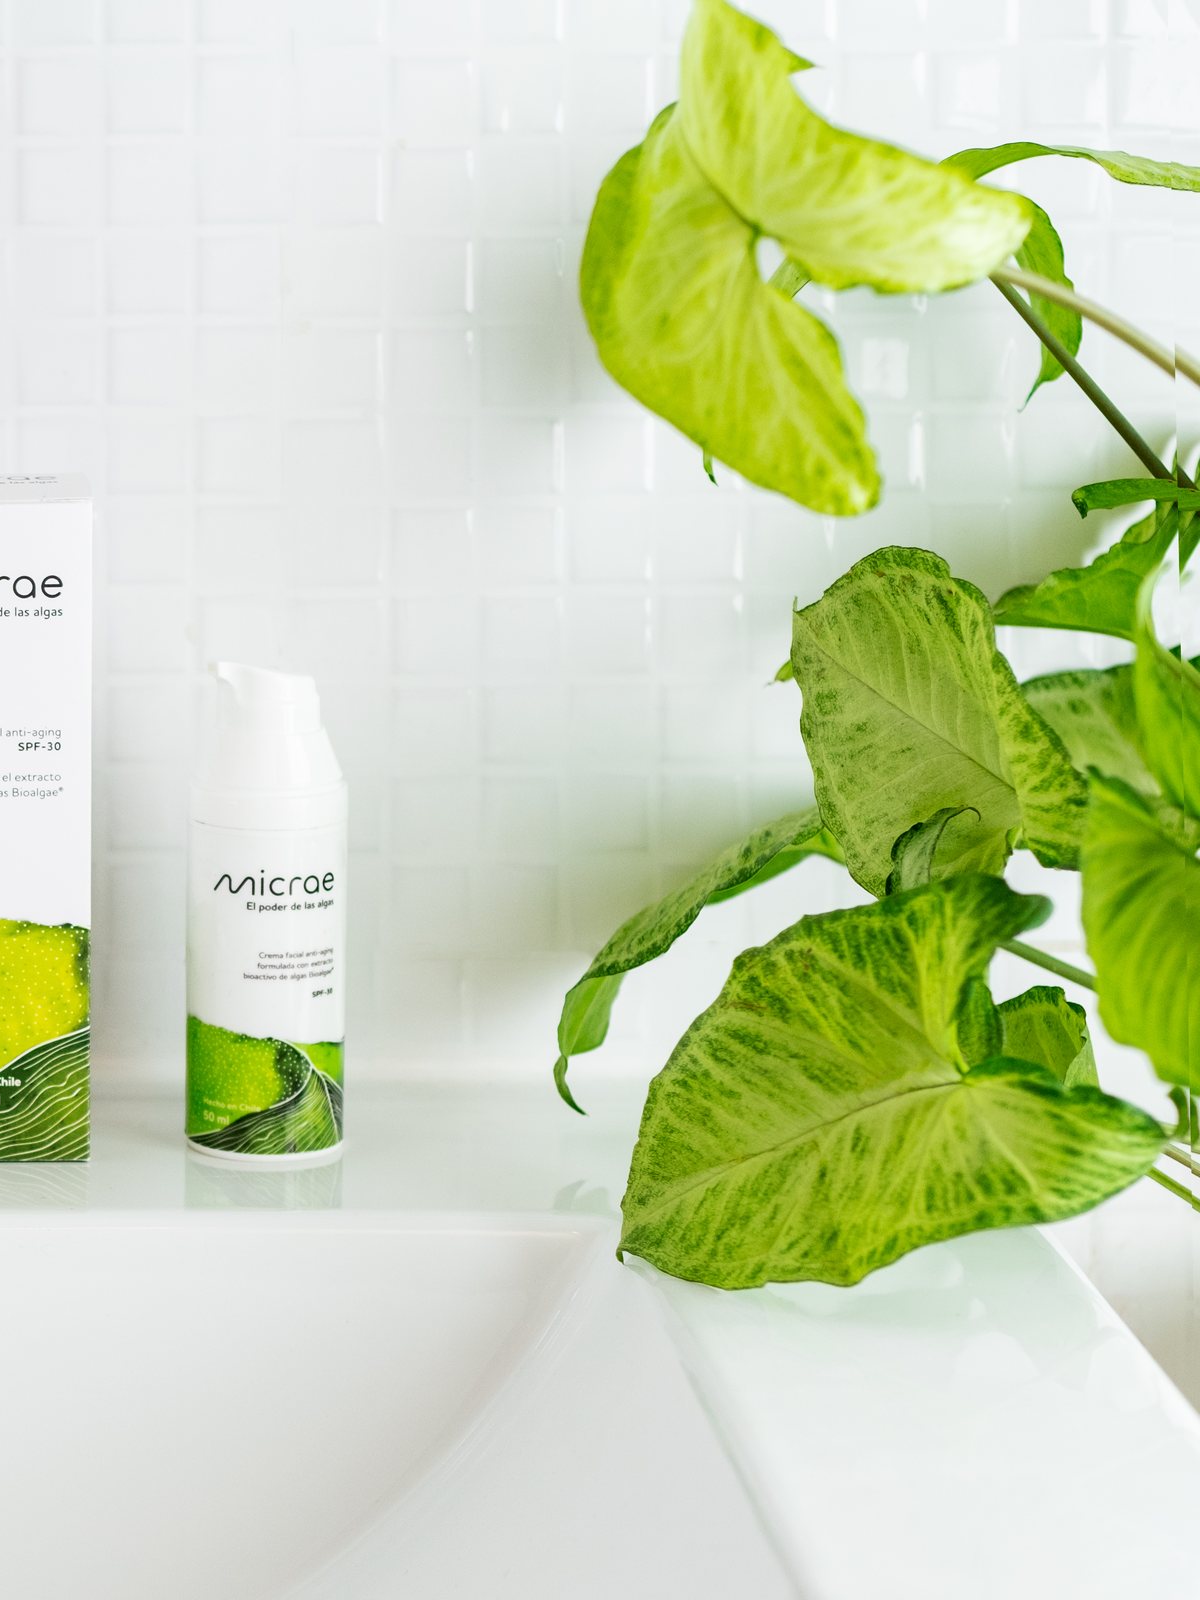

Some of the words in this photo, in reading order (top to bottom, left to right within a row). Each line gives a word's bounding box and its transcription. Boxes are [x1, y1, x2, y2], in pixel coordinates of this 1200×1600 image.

[14, 606, 30, 617] las
[33, 606, 63, 619] algas
[5, 728, 62, 739] anti-aging
[18, 742, 61, 751] SPF-30
[2, 773, 12, 782] el
[14, 773, 62, 782] extracto
[213, 869, 335, 896] micrae
[246, 901, 256, 910] El
[259, 902, 288, 914] poder
[290, 902, 302, 911] de
[304, 901, 315, 910] las
[258, 951, 284, 959] Crema
[257, 961, 295, 970] formulada
[243, 971, 277, 981] bioactivo
[278, 972, 288, 981] de
[203, 1109, 215, 1122] 50
[216, 1115, 230, 1126] ml
